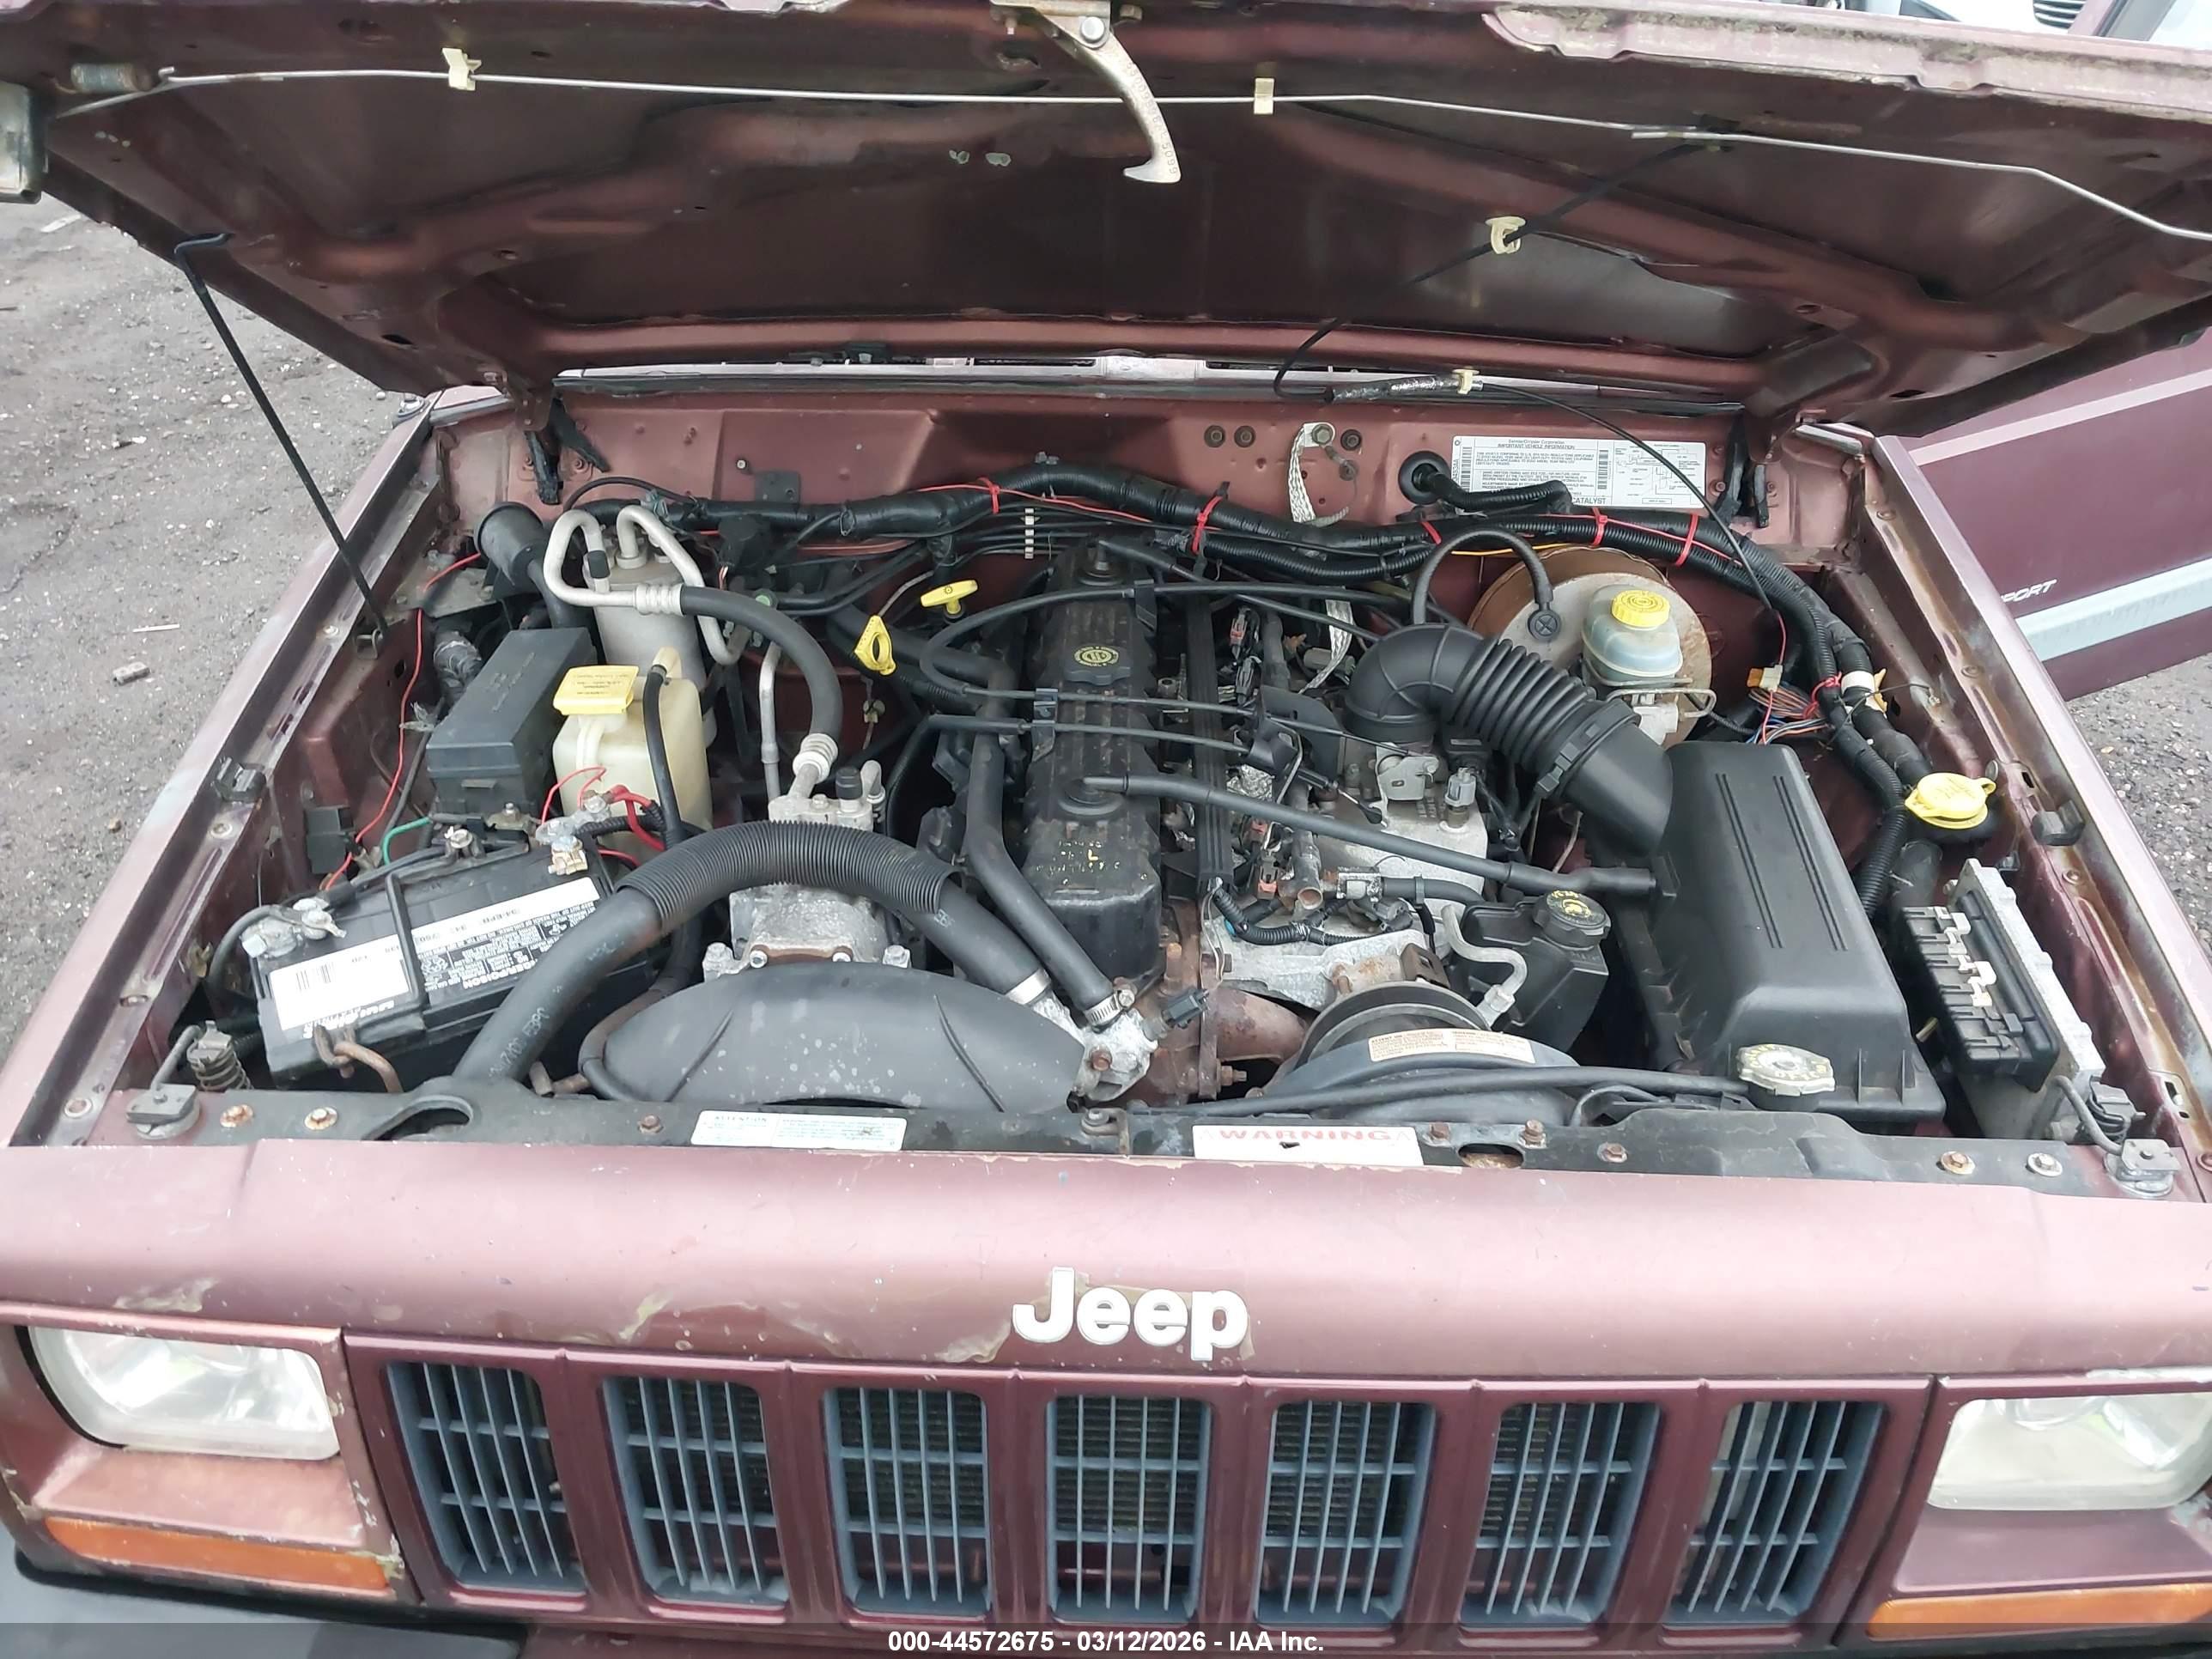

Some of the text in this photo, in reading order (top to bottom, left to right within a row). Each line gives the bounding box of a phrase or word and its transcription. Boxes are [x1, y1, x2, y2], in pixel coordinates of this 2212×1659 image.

[1999, 579, 2057, 603] PORT
[1219, 1130, 1392, 1140] WARNING
[1012, 1267, 1249, 1361] Jeep
